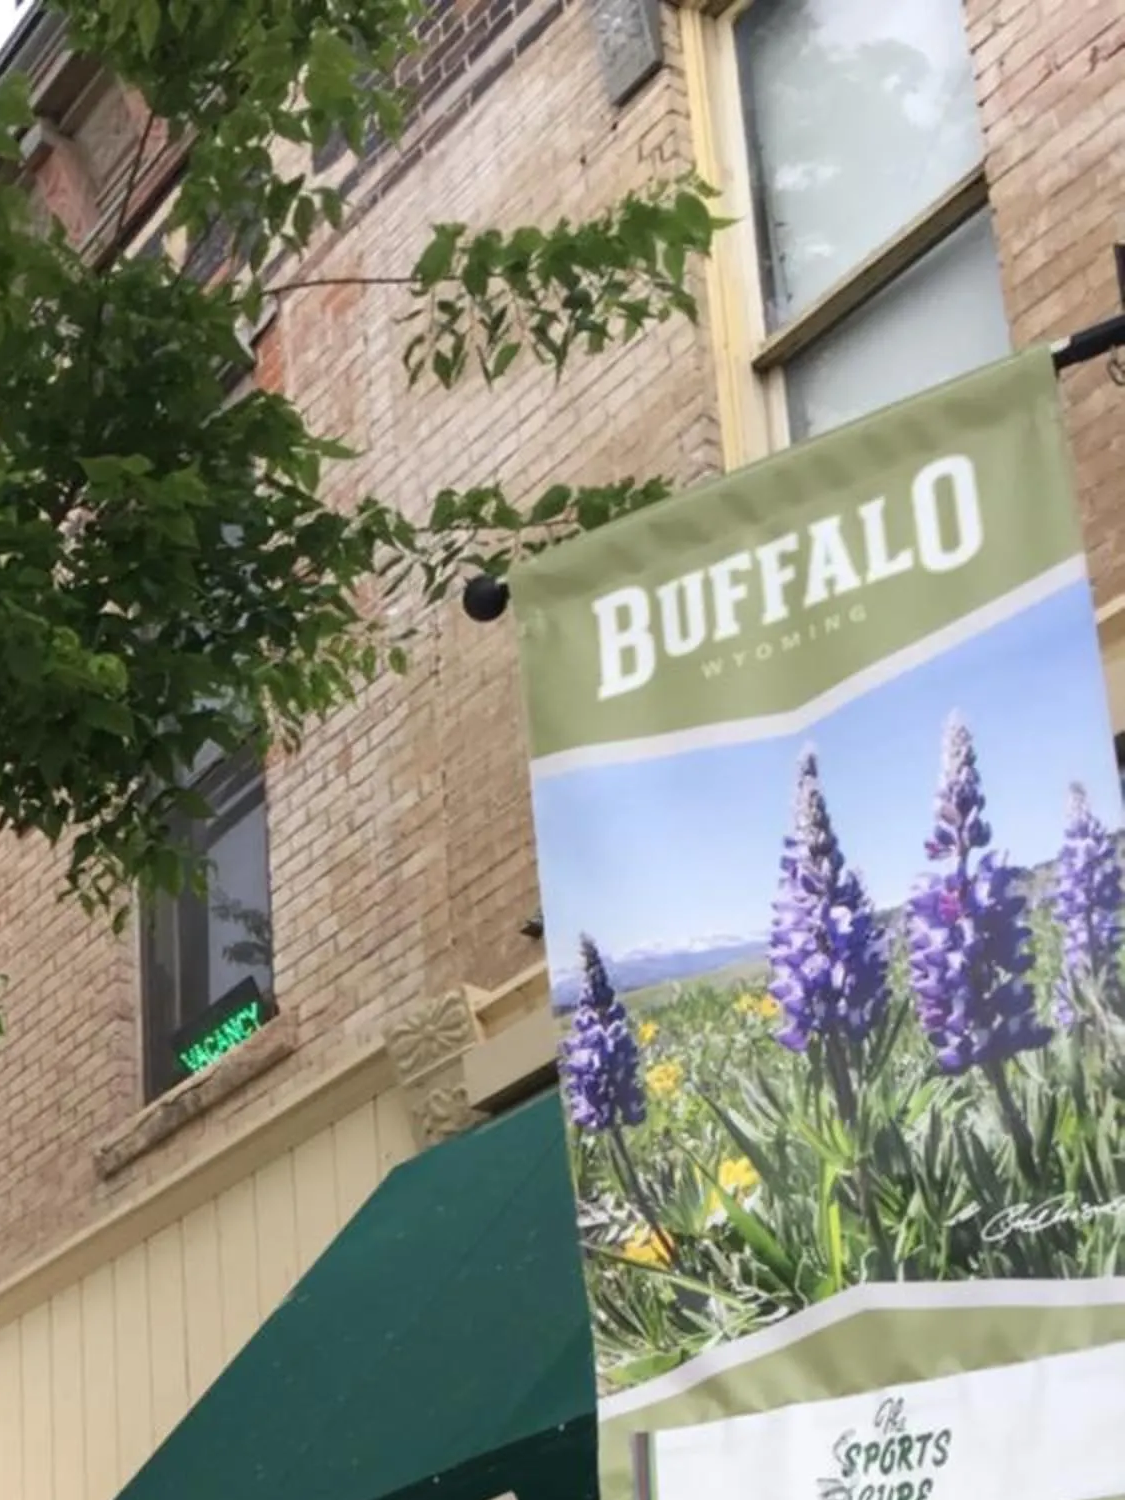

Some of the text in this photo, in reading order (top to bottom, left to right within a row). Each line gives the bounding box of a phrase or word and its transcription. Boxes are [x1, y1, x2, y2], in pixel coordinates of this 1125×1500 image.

[592, 453, 985, 701] BUFFALO
[700, 603, 869, 680] WYOMING
[179, 1002, 263, 1076] VACANCY
[841, 1428, 953, 1478] SPORTS
